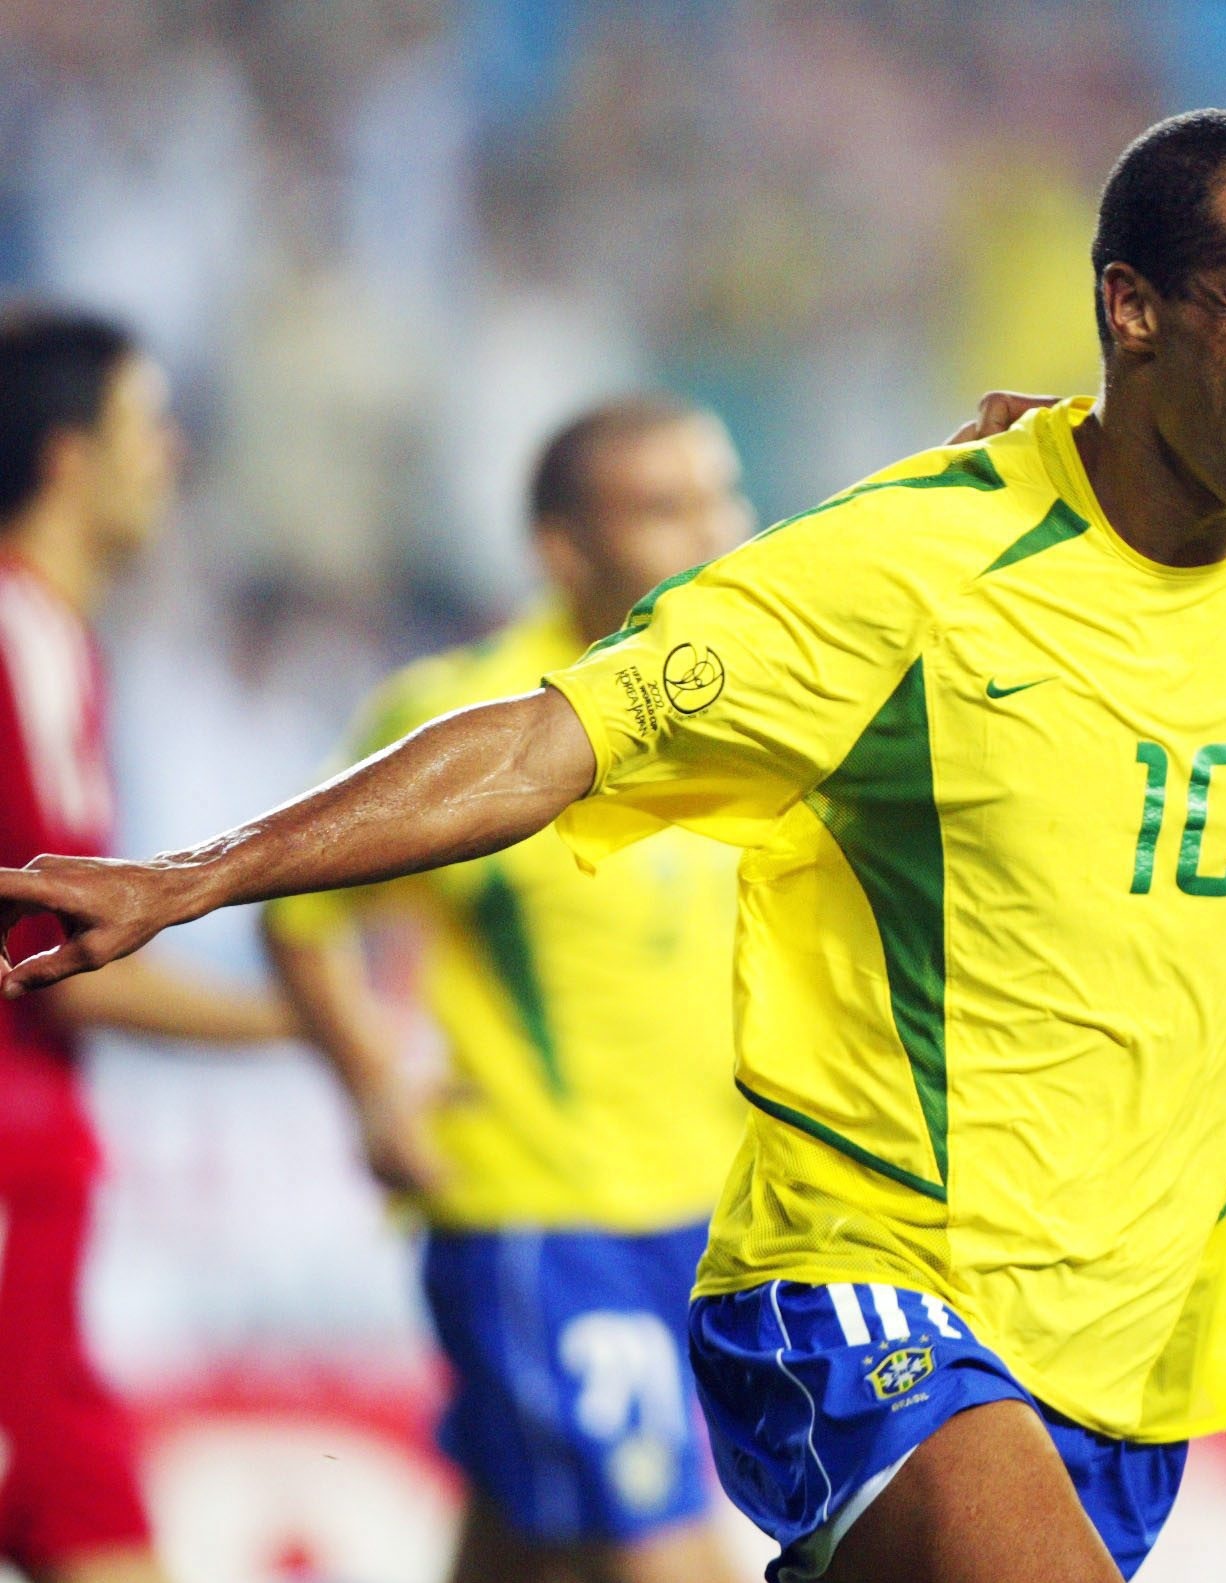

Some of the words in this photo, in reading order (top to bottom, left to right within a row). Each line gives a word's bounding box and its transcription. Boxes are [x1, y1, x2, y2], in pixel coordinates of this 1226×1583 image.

[615, 669, 639, 706] KOREA
[640, 685, 655, 715] WORLD
[647, 681, 665, 709] 2002
[626, 704, 647, 737] JAPAN
